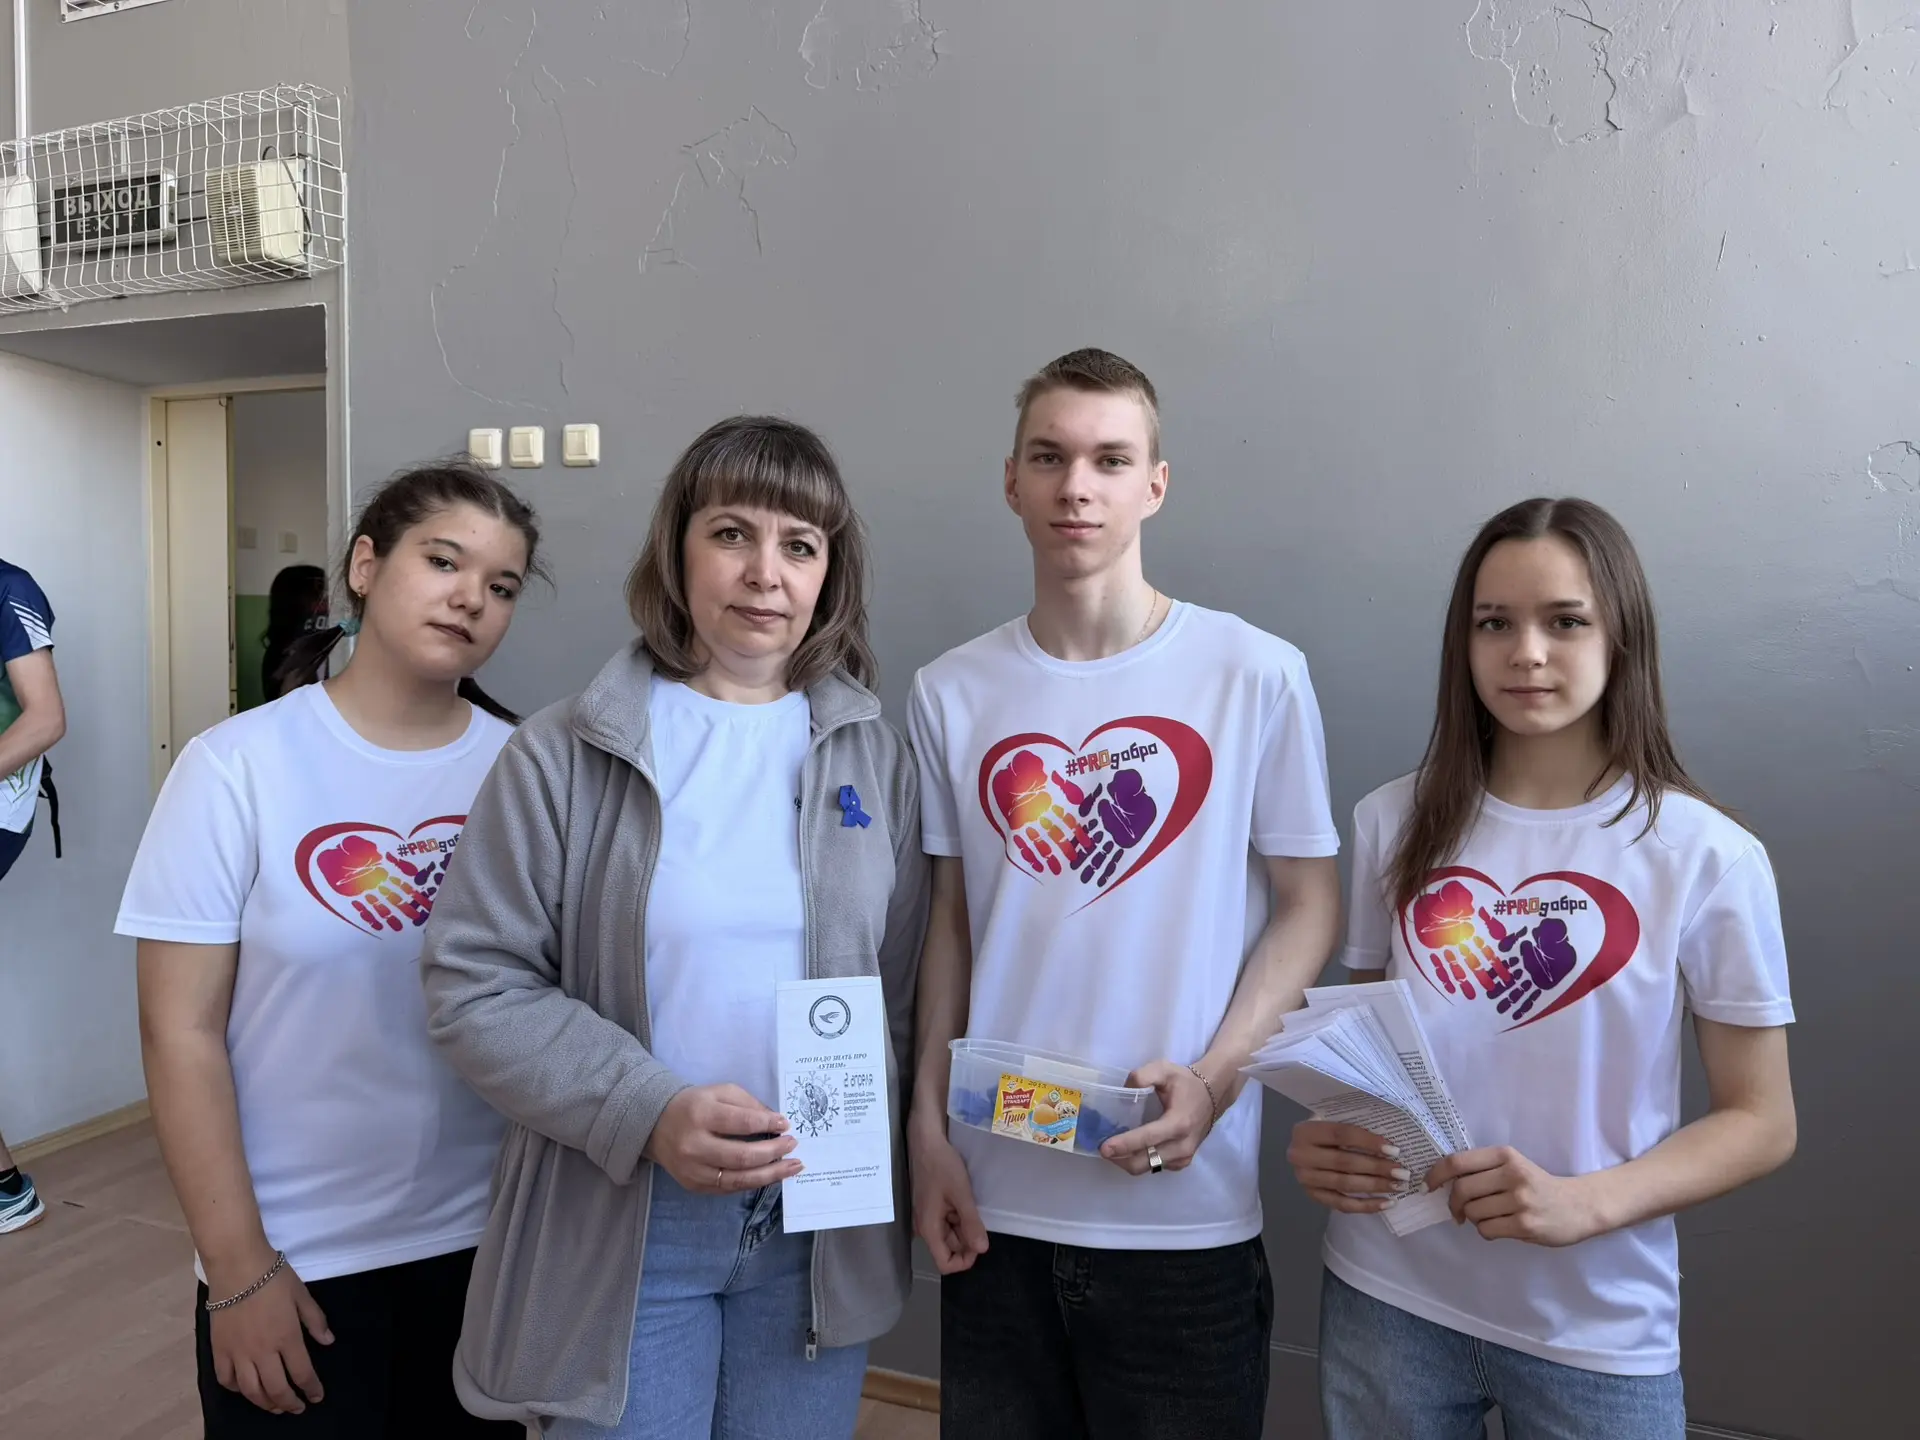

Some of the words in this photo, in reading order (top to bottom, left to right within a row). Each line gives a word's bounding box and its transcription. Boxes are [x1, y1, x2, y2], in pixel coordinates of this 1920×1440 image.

[63, 186, 152, 216] ВЫХОД
[396, 833, 460, 857] #PROдо
[1002, 1110, 1026, 1127] Трио
